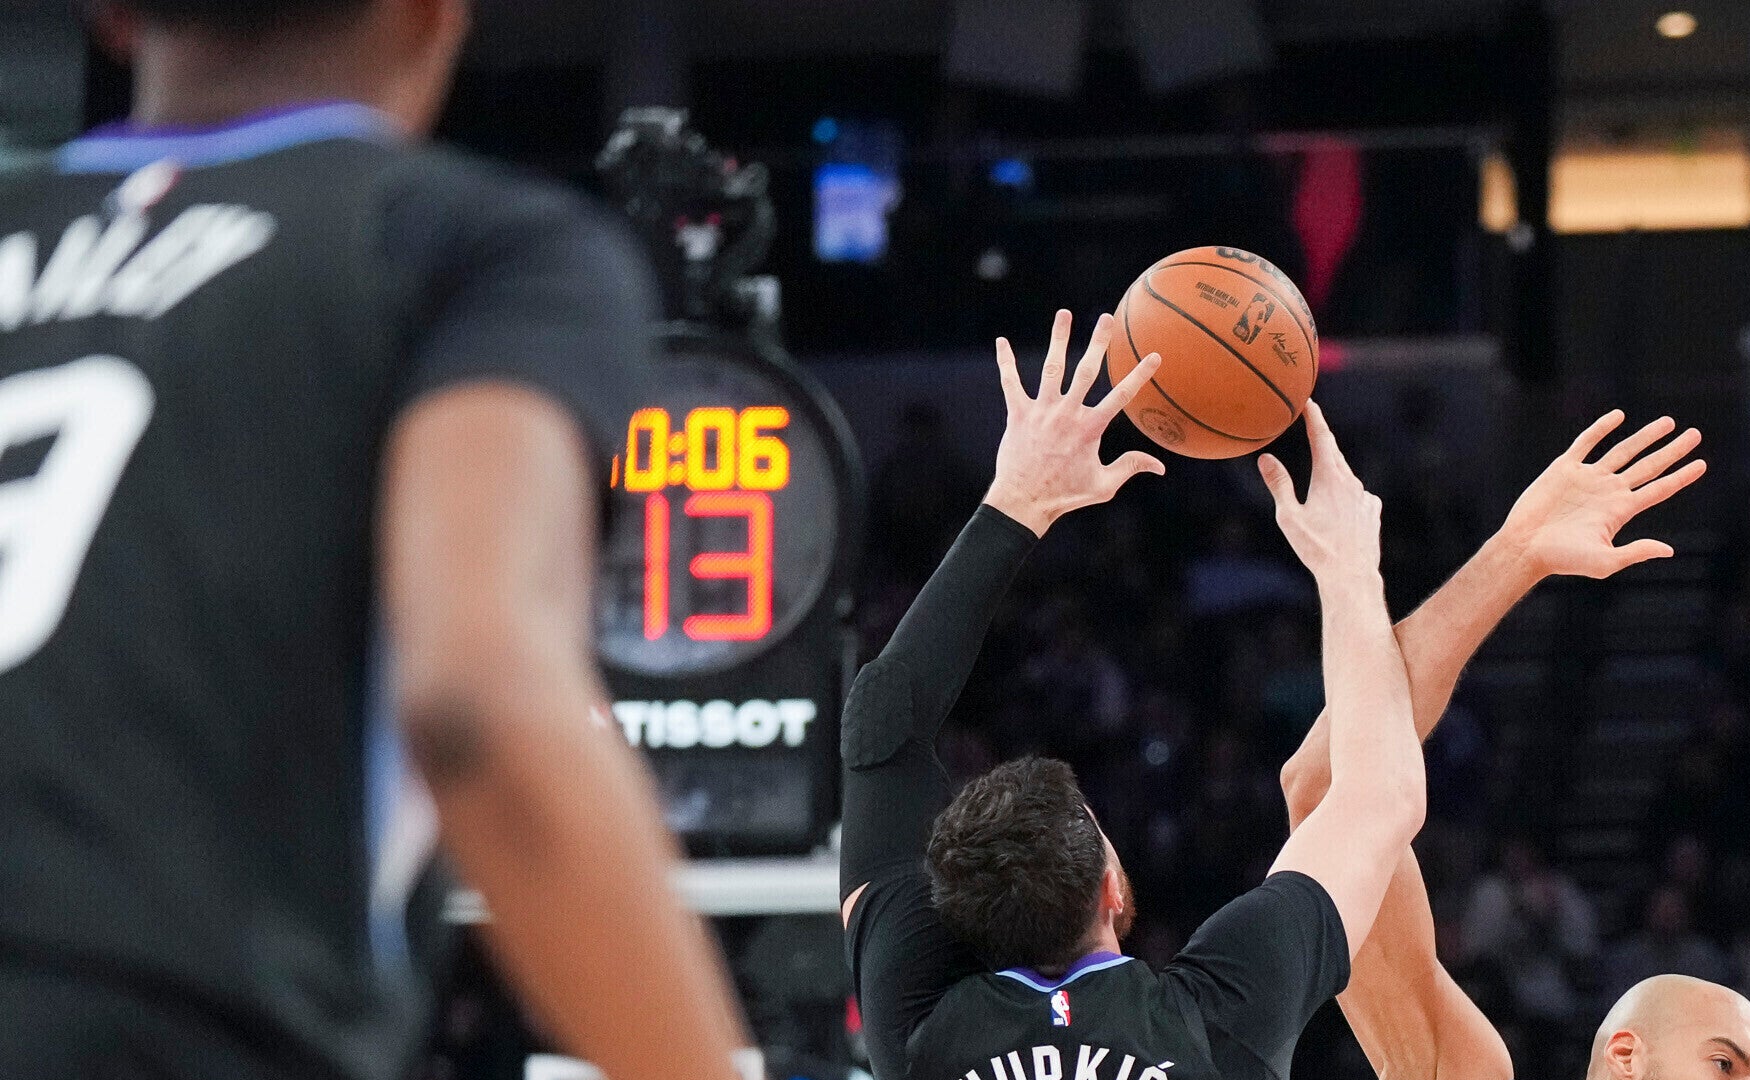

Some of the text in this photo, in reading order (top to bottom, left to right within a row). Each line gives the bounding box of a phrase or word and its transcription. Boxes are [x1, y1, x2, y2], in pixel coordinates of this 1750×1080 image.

[610, 406, 790, 491] 0:06
[643, 490, 774, 641] 13
[612, 698, 817, 749] TISSOT
